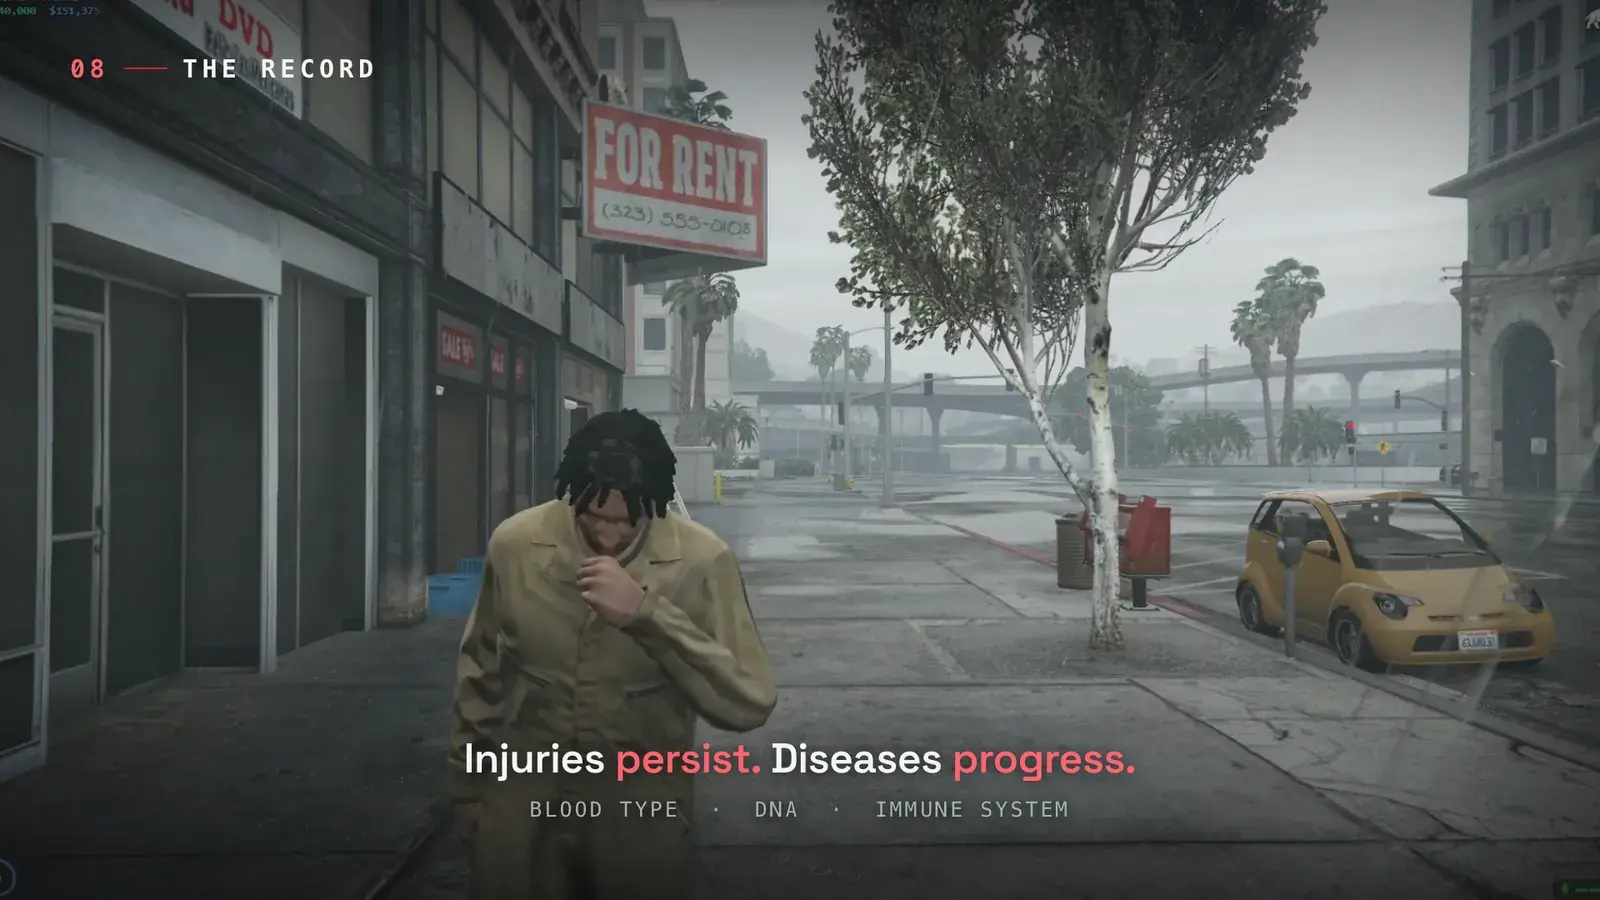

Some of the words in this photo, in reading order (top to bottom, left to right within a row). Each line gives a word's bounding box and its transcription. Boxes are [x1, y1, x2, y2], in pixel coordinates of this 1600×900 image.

[218, 0, 274, 59] DVD
[594, 116, 664, 190] FOR
[672, 134, 758, 207] RENT
[602, 203, 654, 224] (323)
